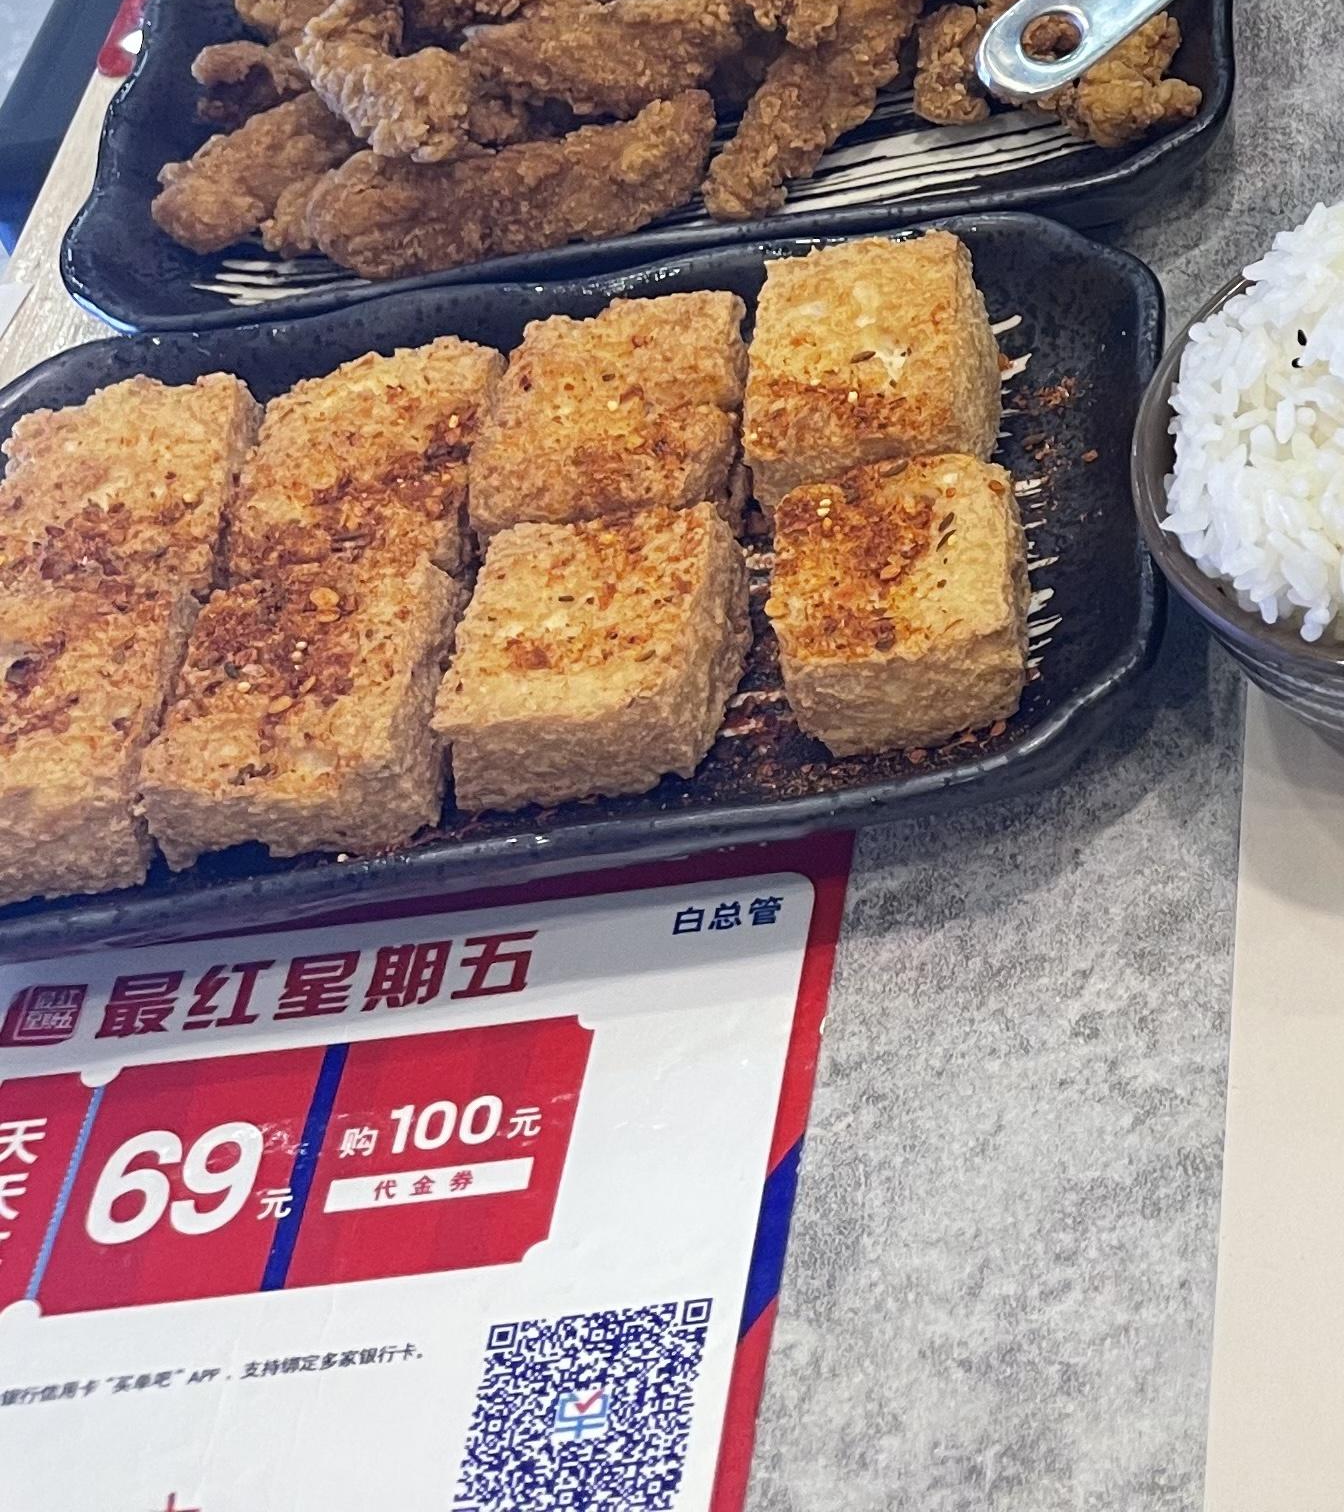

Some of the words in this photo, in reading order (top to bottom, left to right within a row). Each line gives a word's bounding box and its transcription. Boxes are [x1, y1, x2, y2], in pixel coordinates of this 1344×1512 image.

[672, 896, 784, 935] 白总管
[94, 929, 540, 1040] 最红星期五
[338, 1126, 379, 1160] 购
[390, 1094, 503, 1154] 100
[507, 1106, 543, 1140] 元
[84, 1121, 266, 1245] 69
[257, 1187, 294, 1221] 元
[373, 1170, 474, 1201] 代金券
